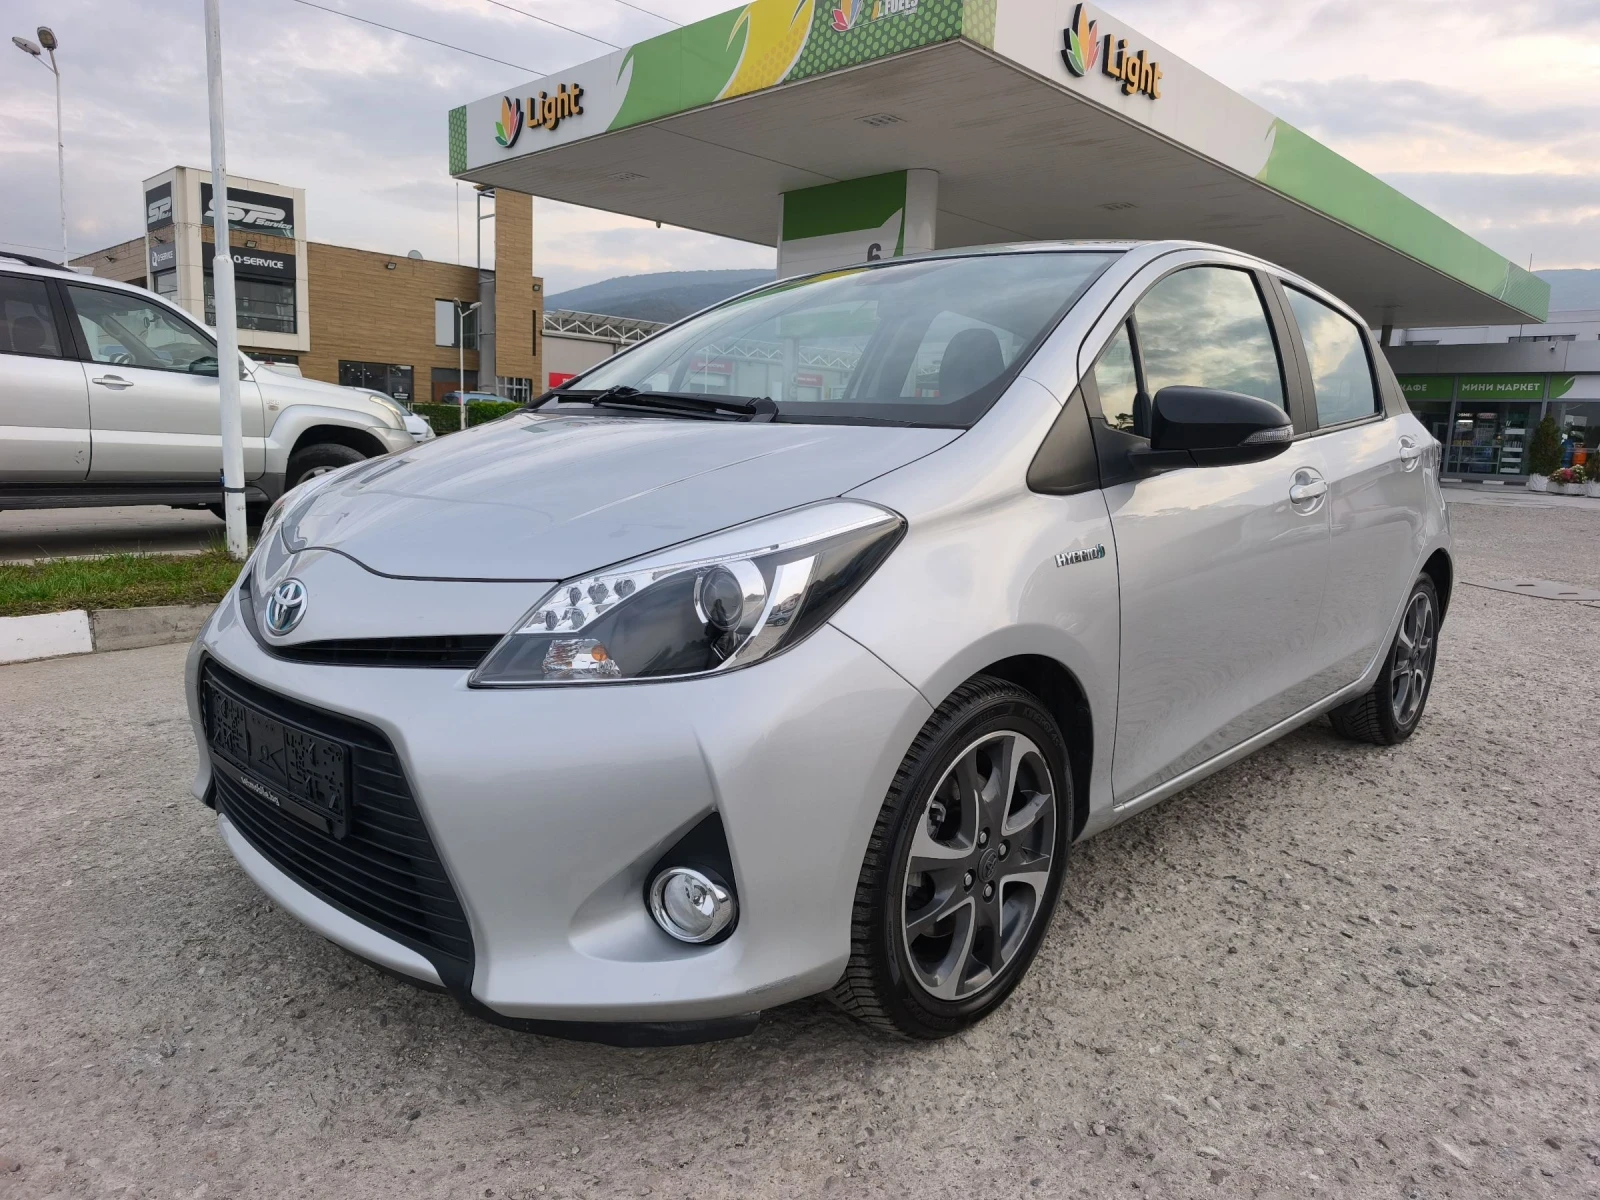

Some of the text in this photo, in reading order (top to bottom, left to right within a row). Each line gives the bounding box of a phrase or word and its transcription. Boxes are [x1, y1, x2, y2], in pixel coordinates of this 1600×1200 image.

[1102, 33, 1163, 100] Light
[526, 83, 584, 130] Light
[147, 196, 171, 224] SP
[255, 218, 293, 229] Service
[233, 255, 284, 269] Q-SERVICE
[867, 243, 882, 262] 6
[1461, 383, 1541, 392] МИНИ МАРКЕТ
[1054, 547, 1099, 568] HYBRID
